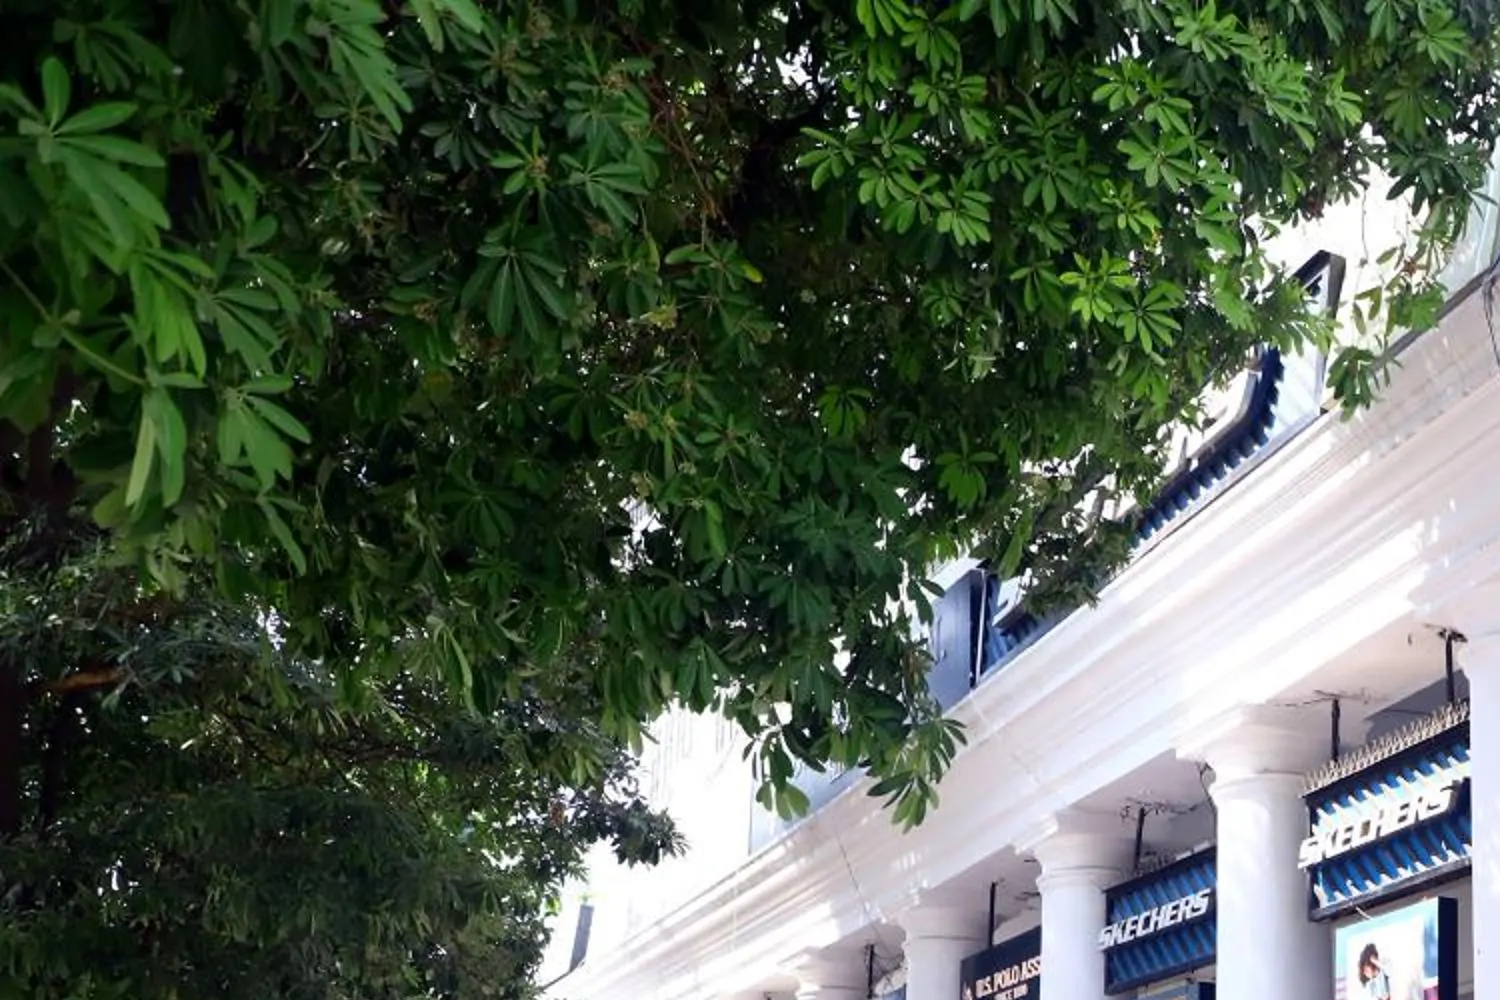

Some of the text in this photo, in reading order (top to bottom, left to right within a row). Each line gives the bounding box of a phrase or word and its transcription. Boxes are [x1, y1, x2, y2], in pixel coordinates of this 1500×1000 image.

[1297, 785, 1455, 867] SKECHERS
[1098, 887, 1212, 950] SKECHERS
[993, 964, 1020, 992] POLO
[1020, 956, 1041, 981] ASS
